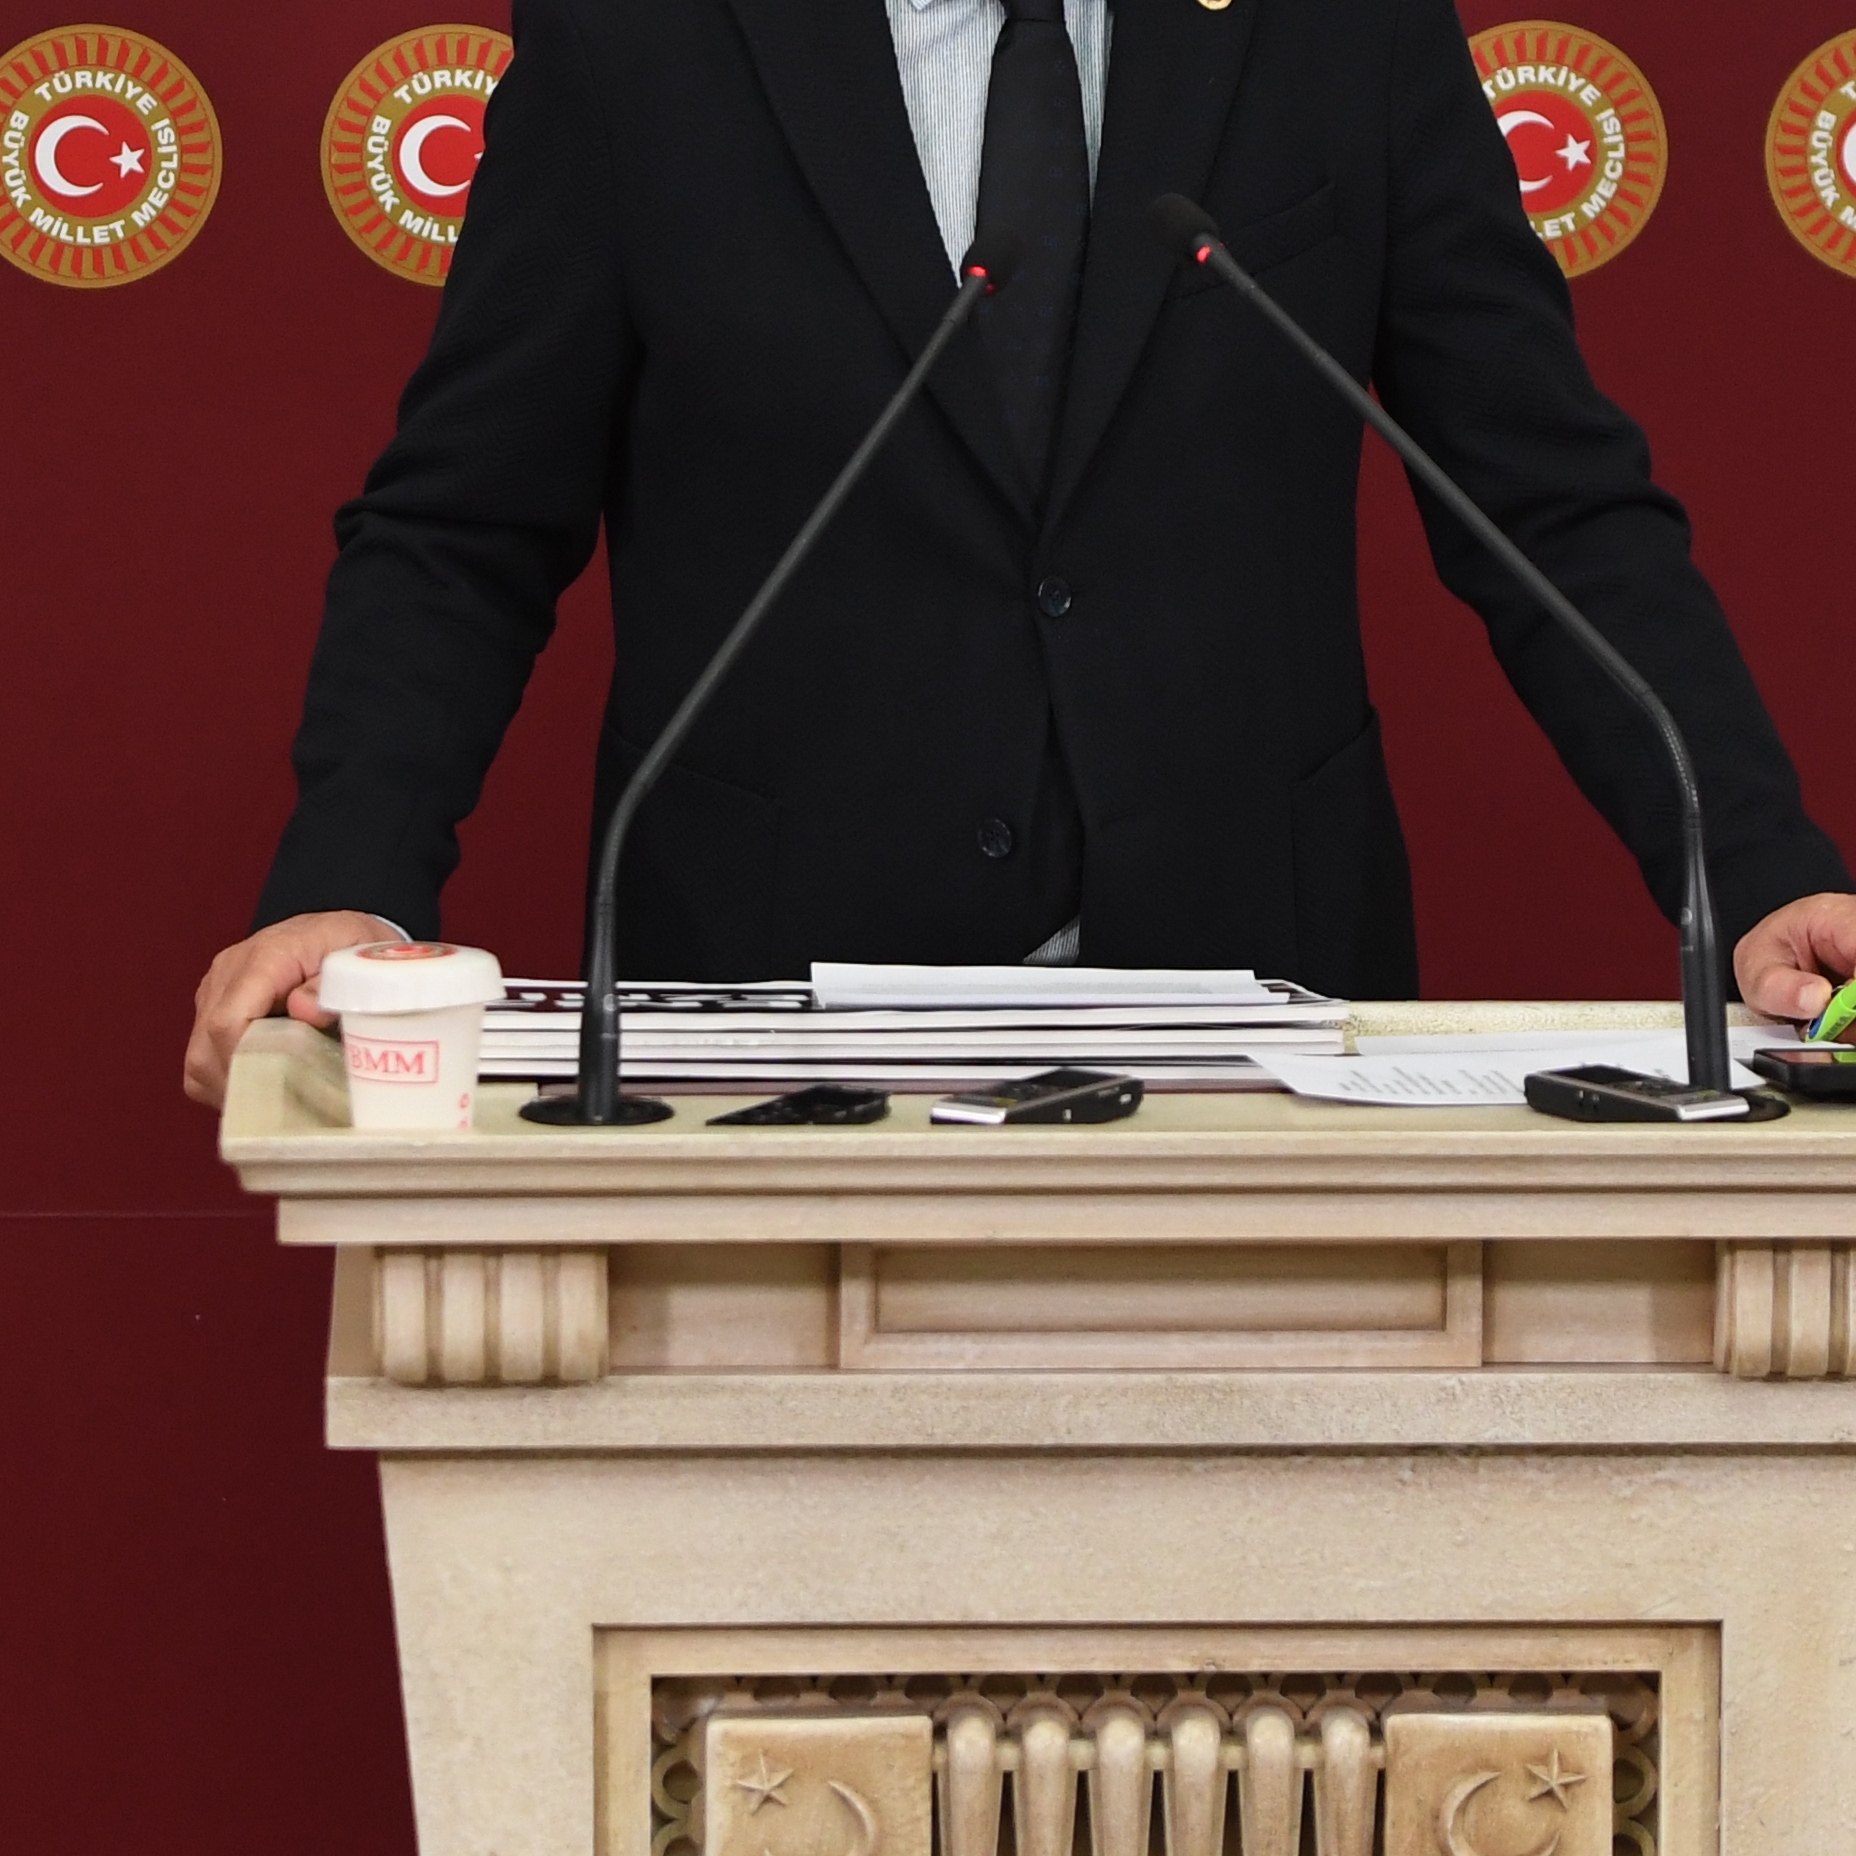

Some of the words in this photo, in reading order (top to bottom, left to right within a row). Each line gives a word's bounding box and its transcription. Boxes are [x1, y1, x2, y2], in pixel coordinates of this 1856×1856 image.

[34, 70, 158, 115] TÜRKİYE
[393, 69, 500, 104] TÜRKİY
[1481, 65, 1602, 107] TÜRKİYE
[1, 110, 32, 209] BÜYÜK
[130, 118, 179, 228] MECLİSİ
[367, 115, 400, 213] BÜYÜK
[1580, 108, 1626, 219] MECLİSİ
[1809, 110, 1841, 208] BÜYÜK
[28, 207, 126, 245] MİLLET
[398, 209, 460, 244] MİLL
[348, 1045, 426, 1074] BMM
